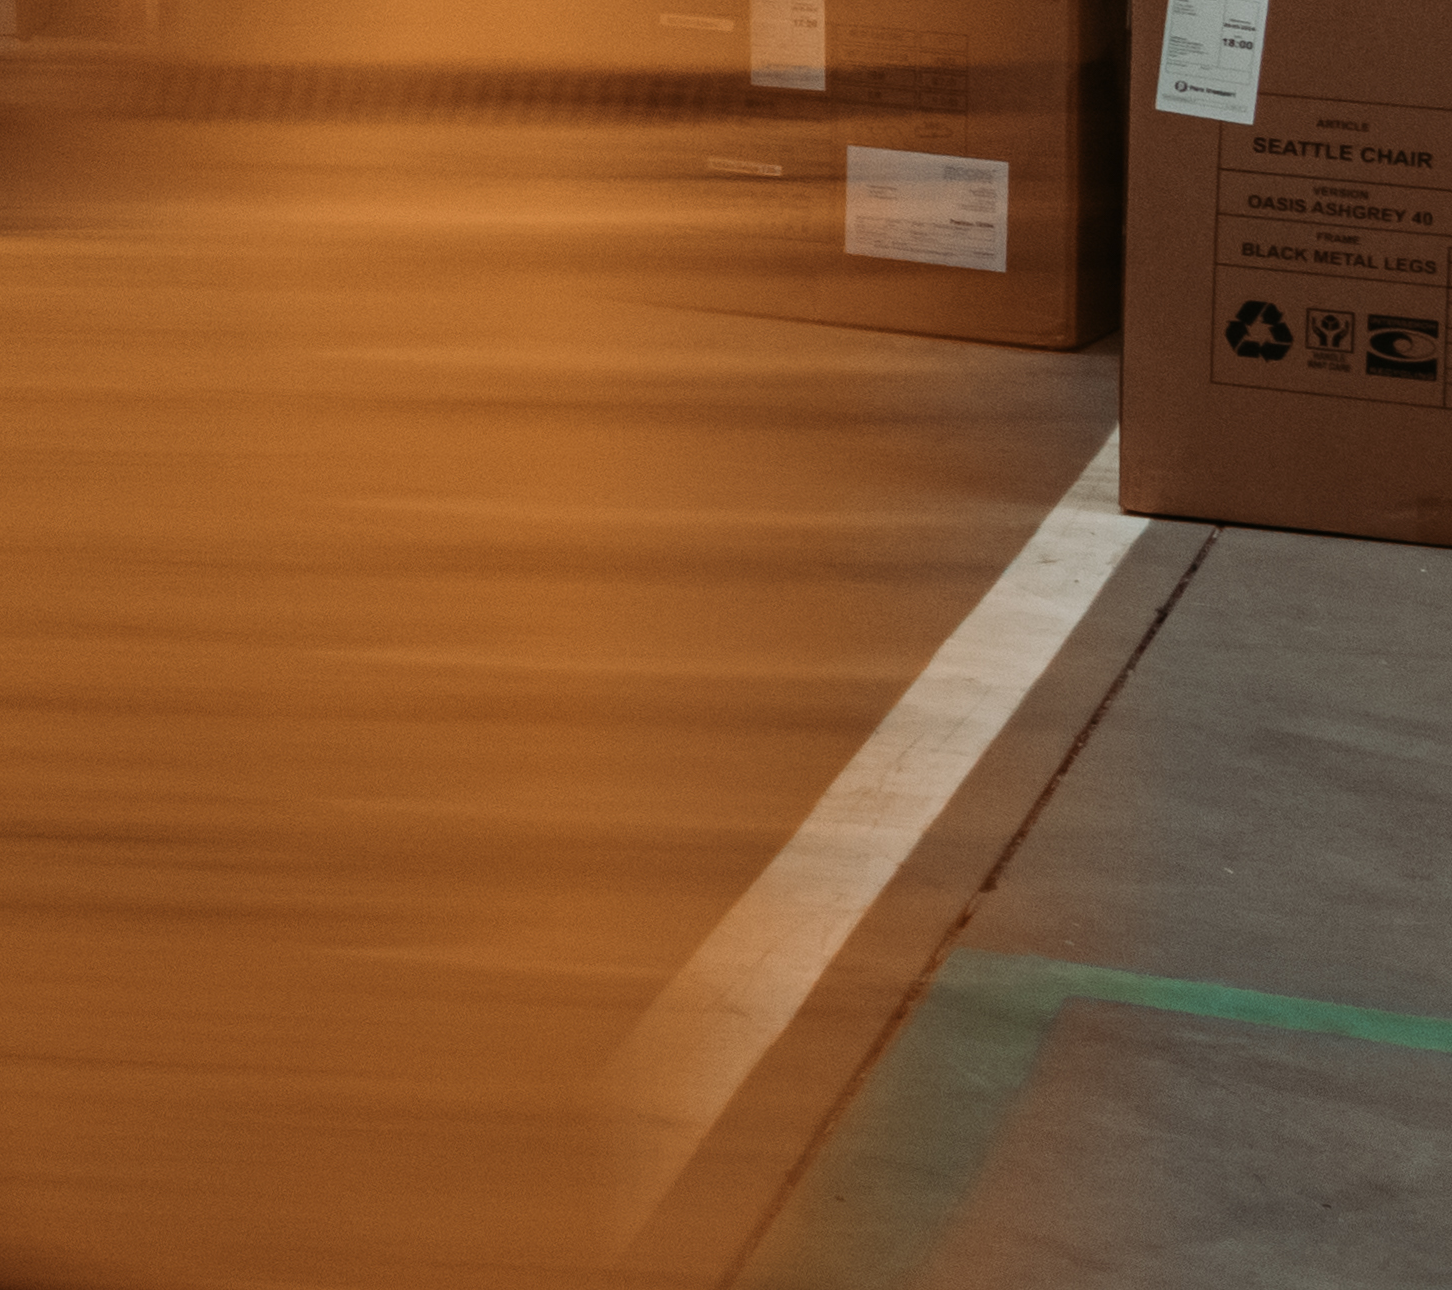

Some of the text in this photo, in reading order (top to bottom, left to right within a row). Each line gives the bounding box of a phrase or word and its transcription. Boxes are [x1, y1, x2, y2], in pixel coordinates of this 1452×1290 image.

[1253, 137, 1433, 168] SEATTLE CHAIR
[1247, 194, 1434, 226] OASIS ASHGREY 40
[1241, 242, 1437, 275] BLACK METAL LEGS
